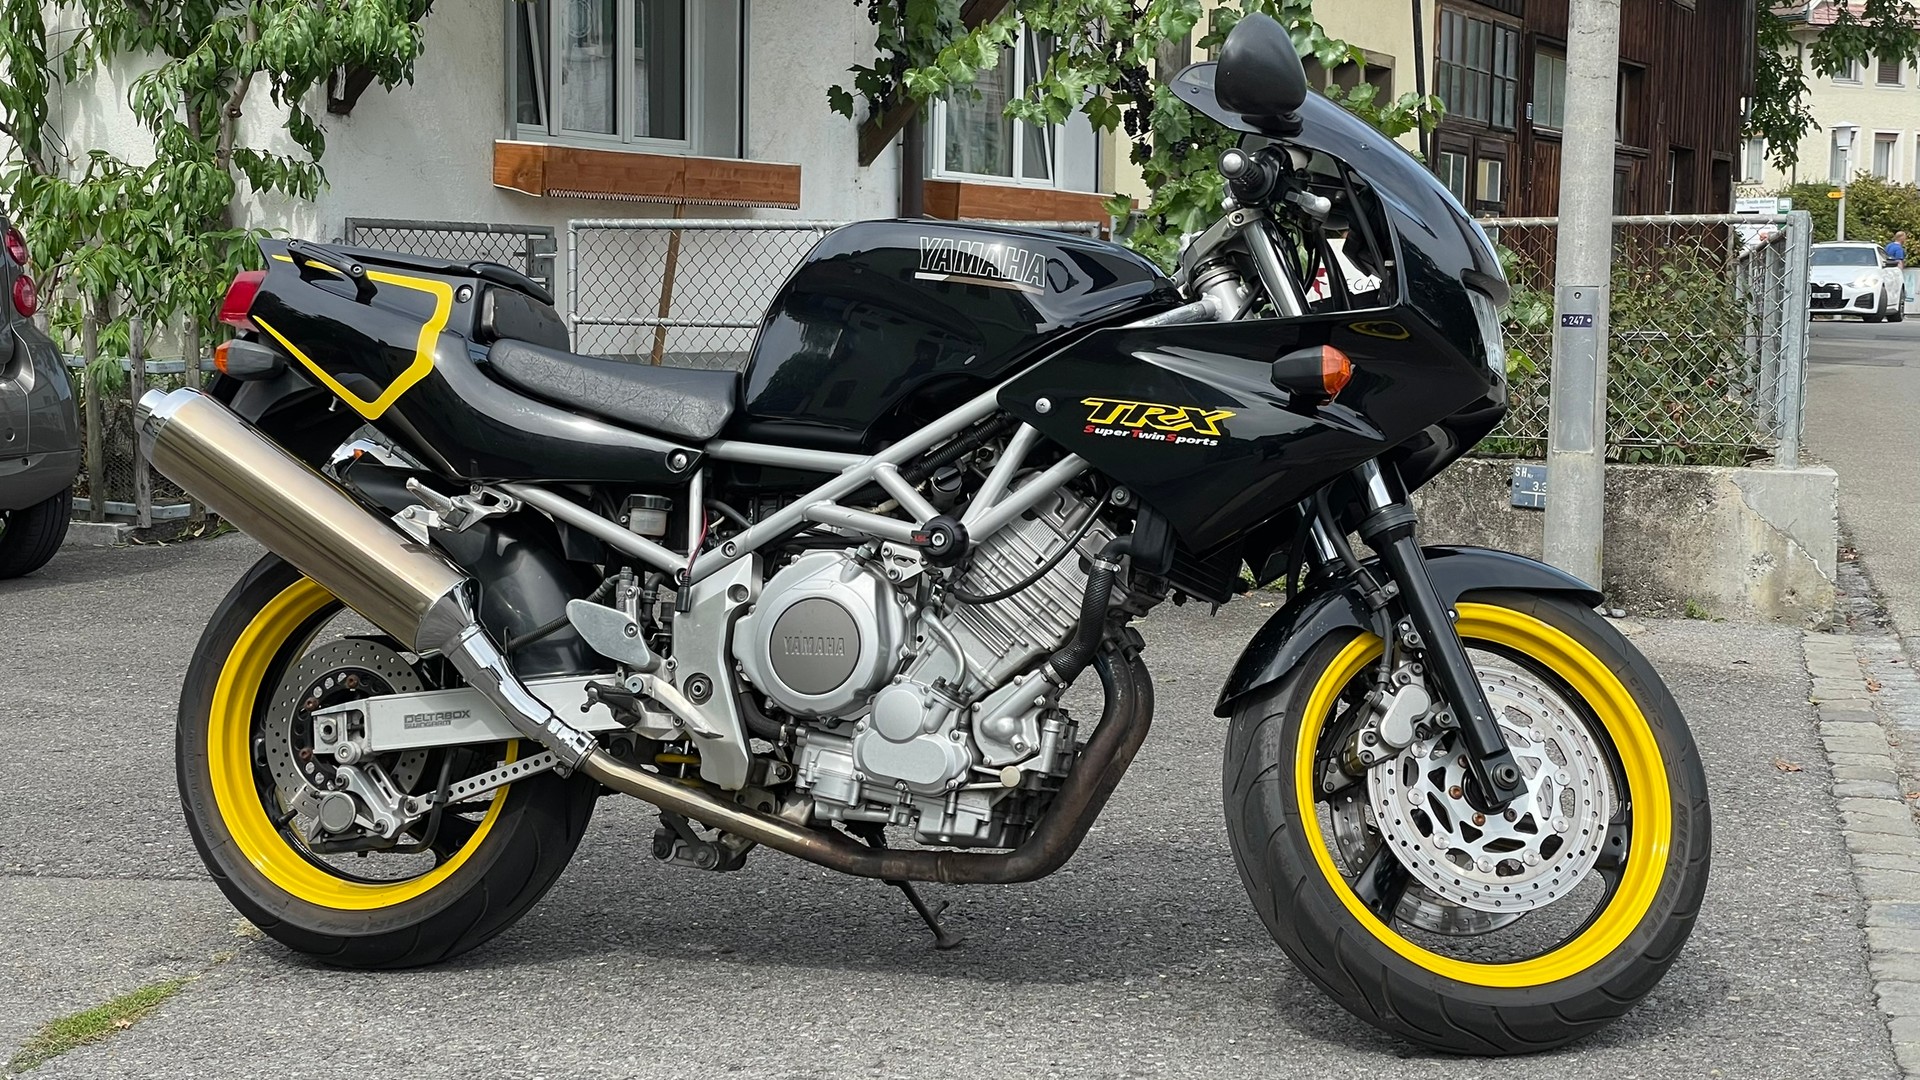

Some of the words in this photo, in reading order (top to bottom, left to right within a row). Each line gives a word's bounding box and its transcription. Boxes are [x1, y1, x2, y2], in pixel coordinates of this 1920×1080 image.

[919, 236, 1047, 288] YAMAHA
[1568, 315, 1585, 325] 247
[1080, 397, 1237, 436] TRX
[783, 636, 845, 657] YAMAHA
[403, 710, 471, 723] DELTABOX
[1642, 803, 1689, 938] MICHELIN
